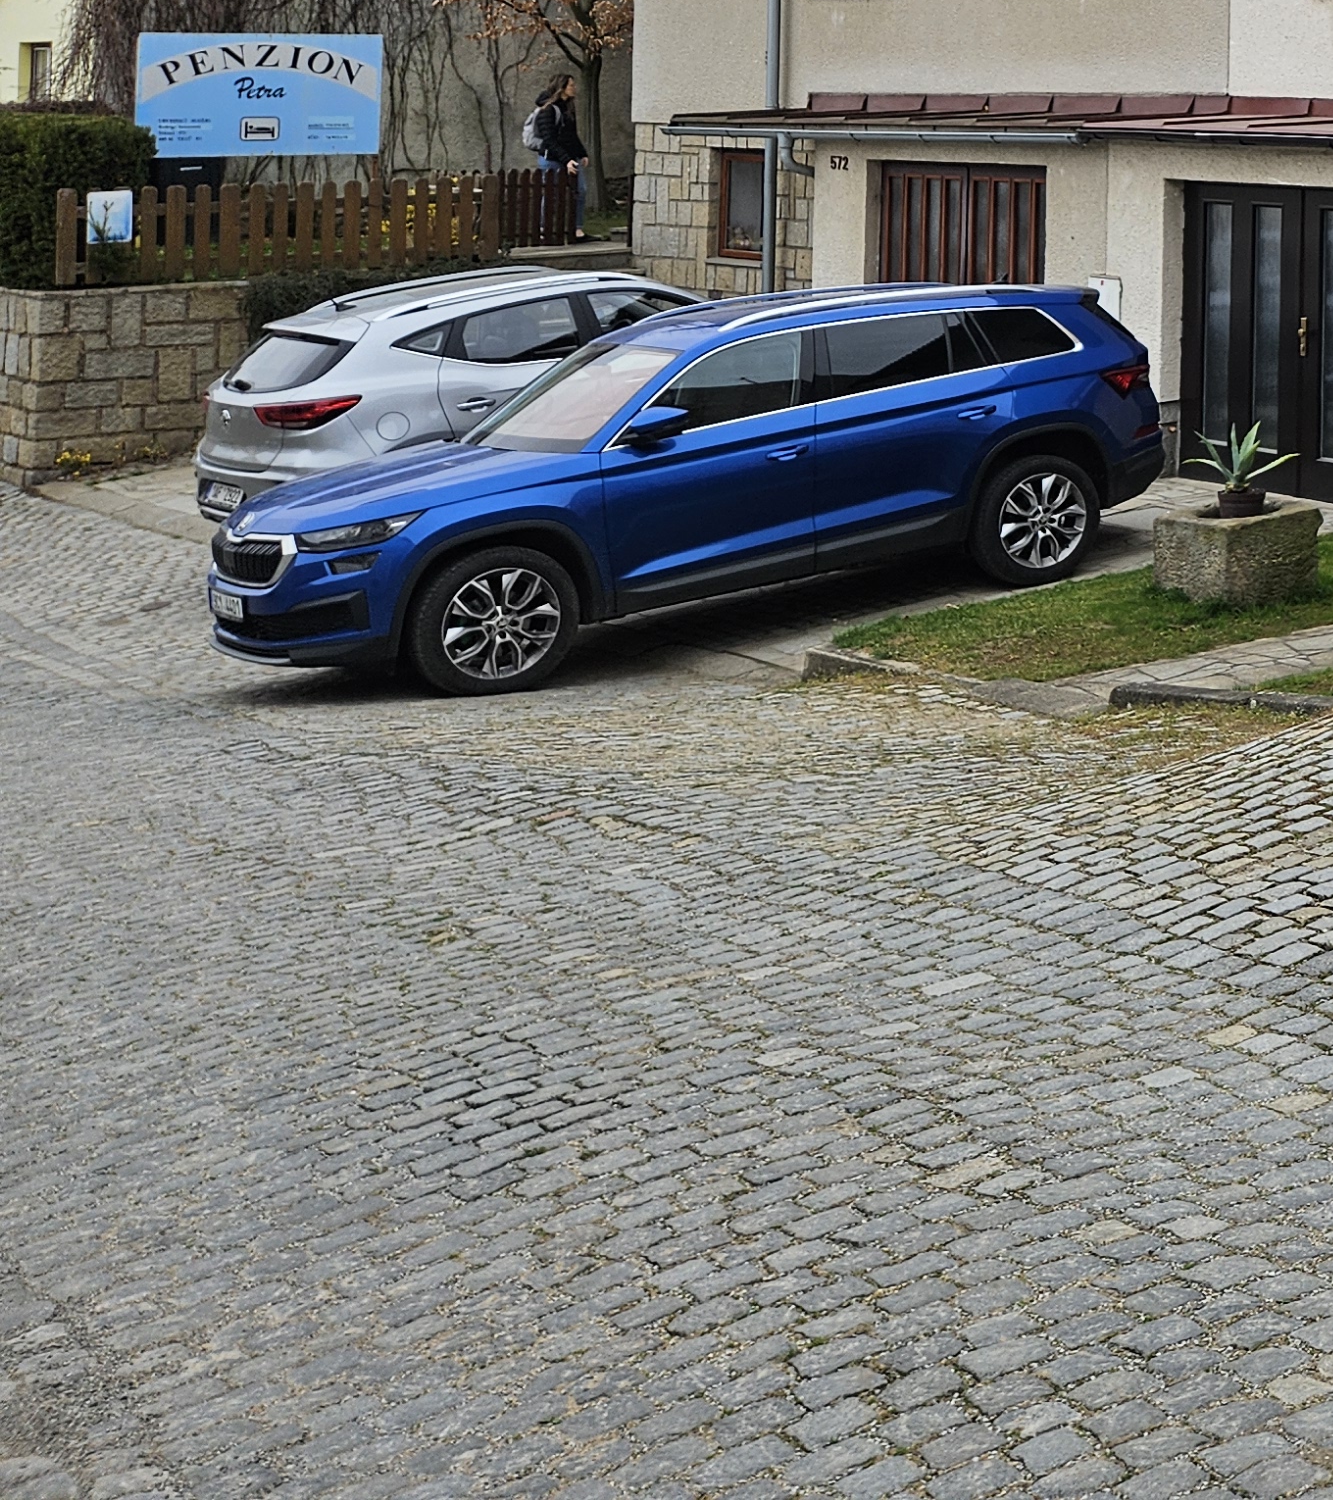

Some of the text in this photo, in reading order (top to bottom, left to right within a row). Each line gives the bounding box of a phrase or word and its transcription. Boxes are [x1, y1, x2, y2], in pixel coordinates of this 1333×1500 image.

[157, 44, 365, 86] PENZION
[234, 77, 288, 100] Petra
[830, 155, 849, 171] 572
